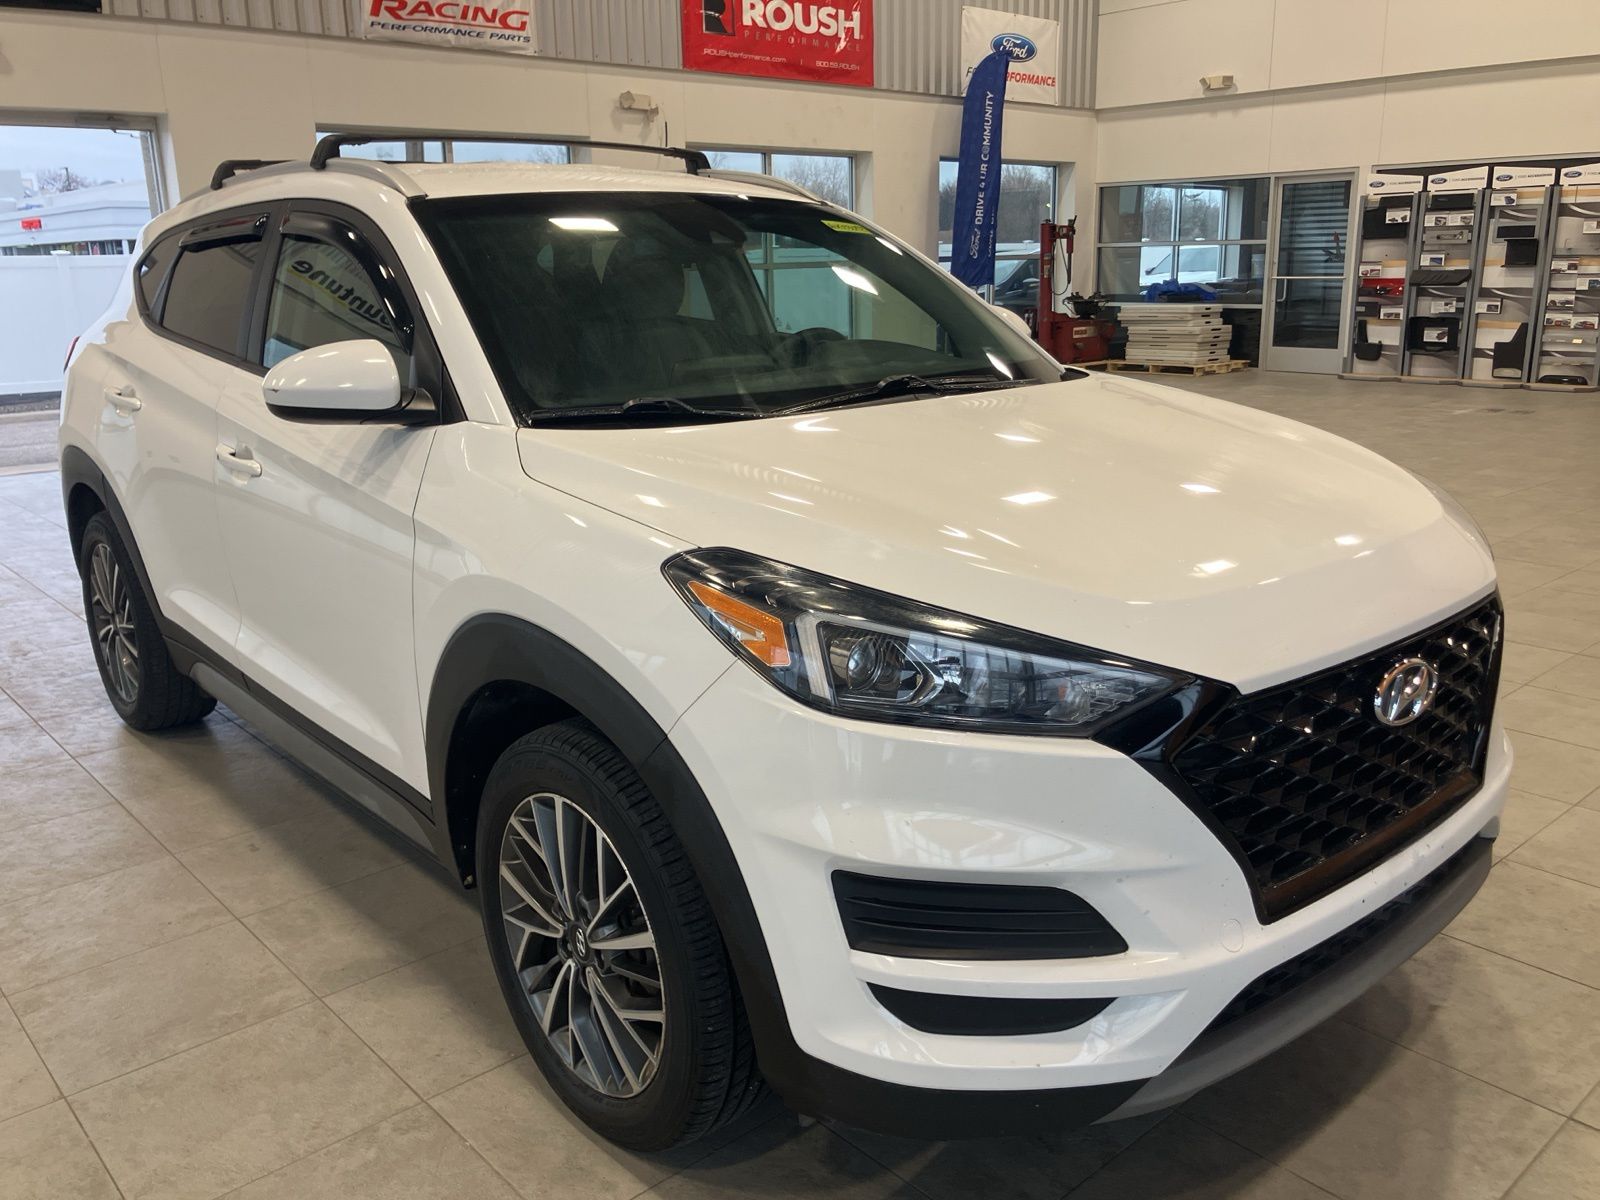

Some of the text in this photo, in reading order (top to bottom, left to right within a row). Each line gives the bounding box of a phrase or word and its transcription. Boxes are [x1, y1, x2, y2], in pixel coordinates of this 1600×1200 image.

[370, 0, 530, 31] RACING
[742, 0, 861, 40] ROUSH
[370, 20, 532, 43] PERFORMANCE PARTS
[1006, 71, 1056, 87] RFORMANCE
[981, 91, 995, 161] COMMUNITY
[975, 190, 985, 225] DRIVE
[969, 228, 983, 259] Ford
